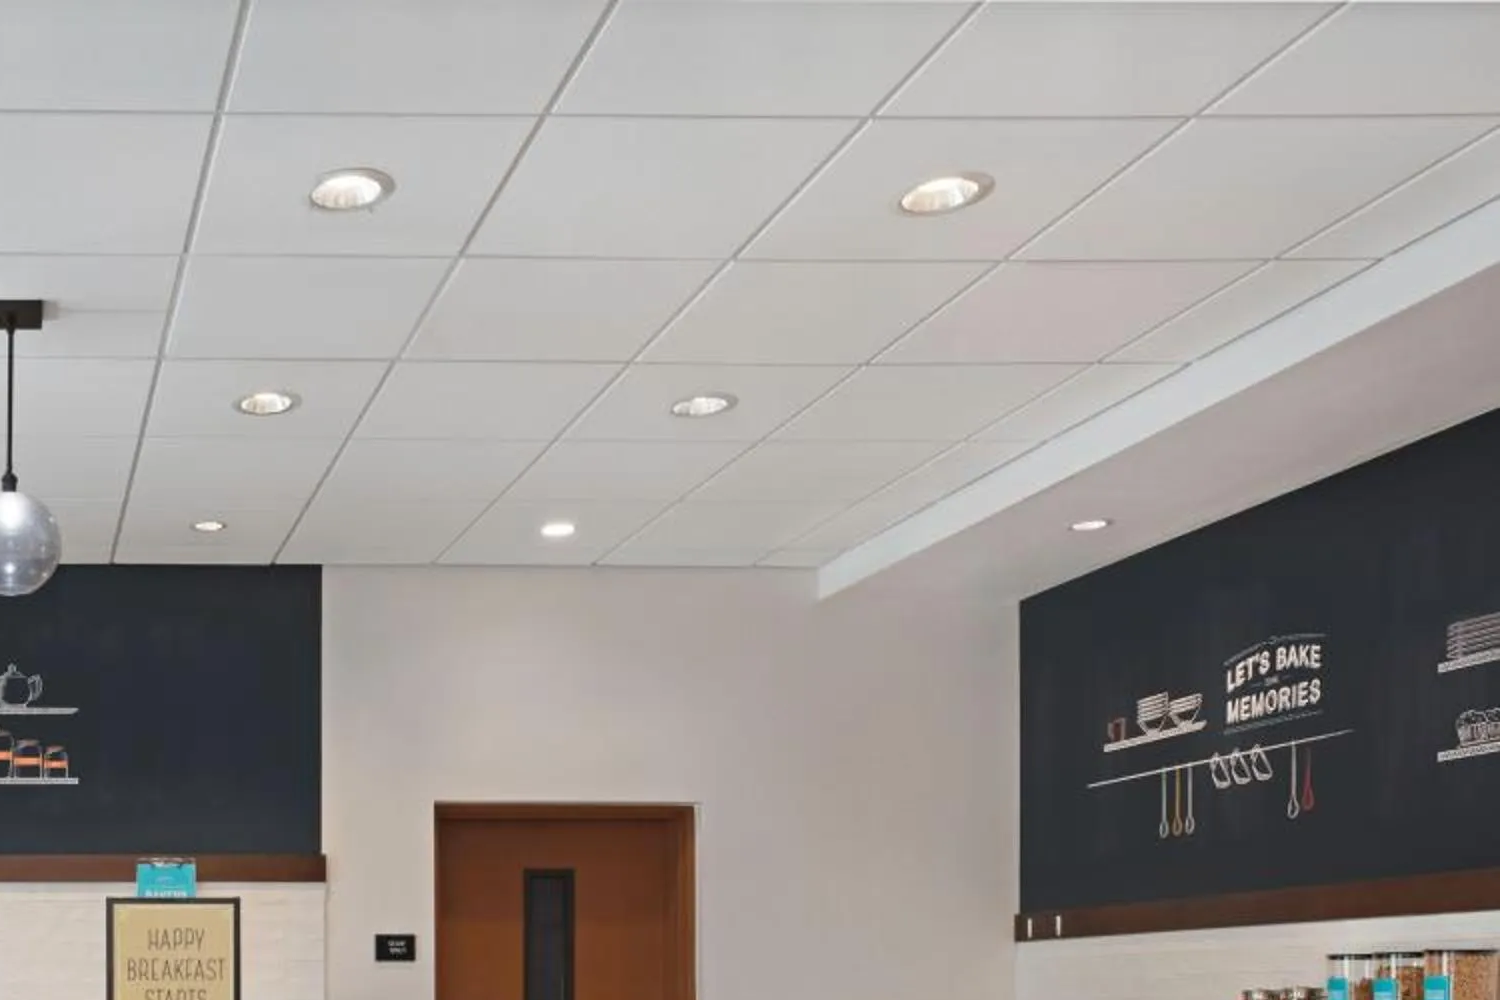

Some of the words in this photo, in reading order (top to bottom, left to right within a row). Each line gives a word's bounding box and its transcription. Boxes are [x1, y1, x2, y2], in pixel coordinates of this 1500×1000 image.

[1226, 651, 1271, 693] LET'S
[1276, 644, 1321, 671] BAKE
[1226, 678, 1321, 724] MEMORIES
[147, 927, 205, 950] HAPPY
[127, 957, 226, 982] BREAKFAST
